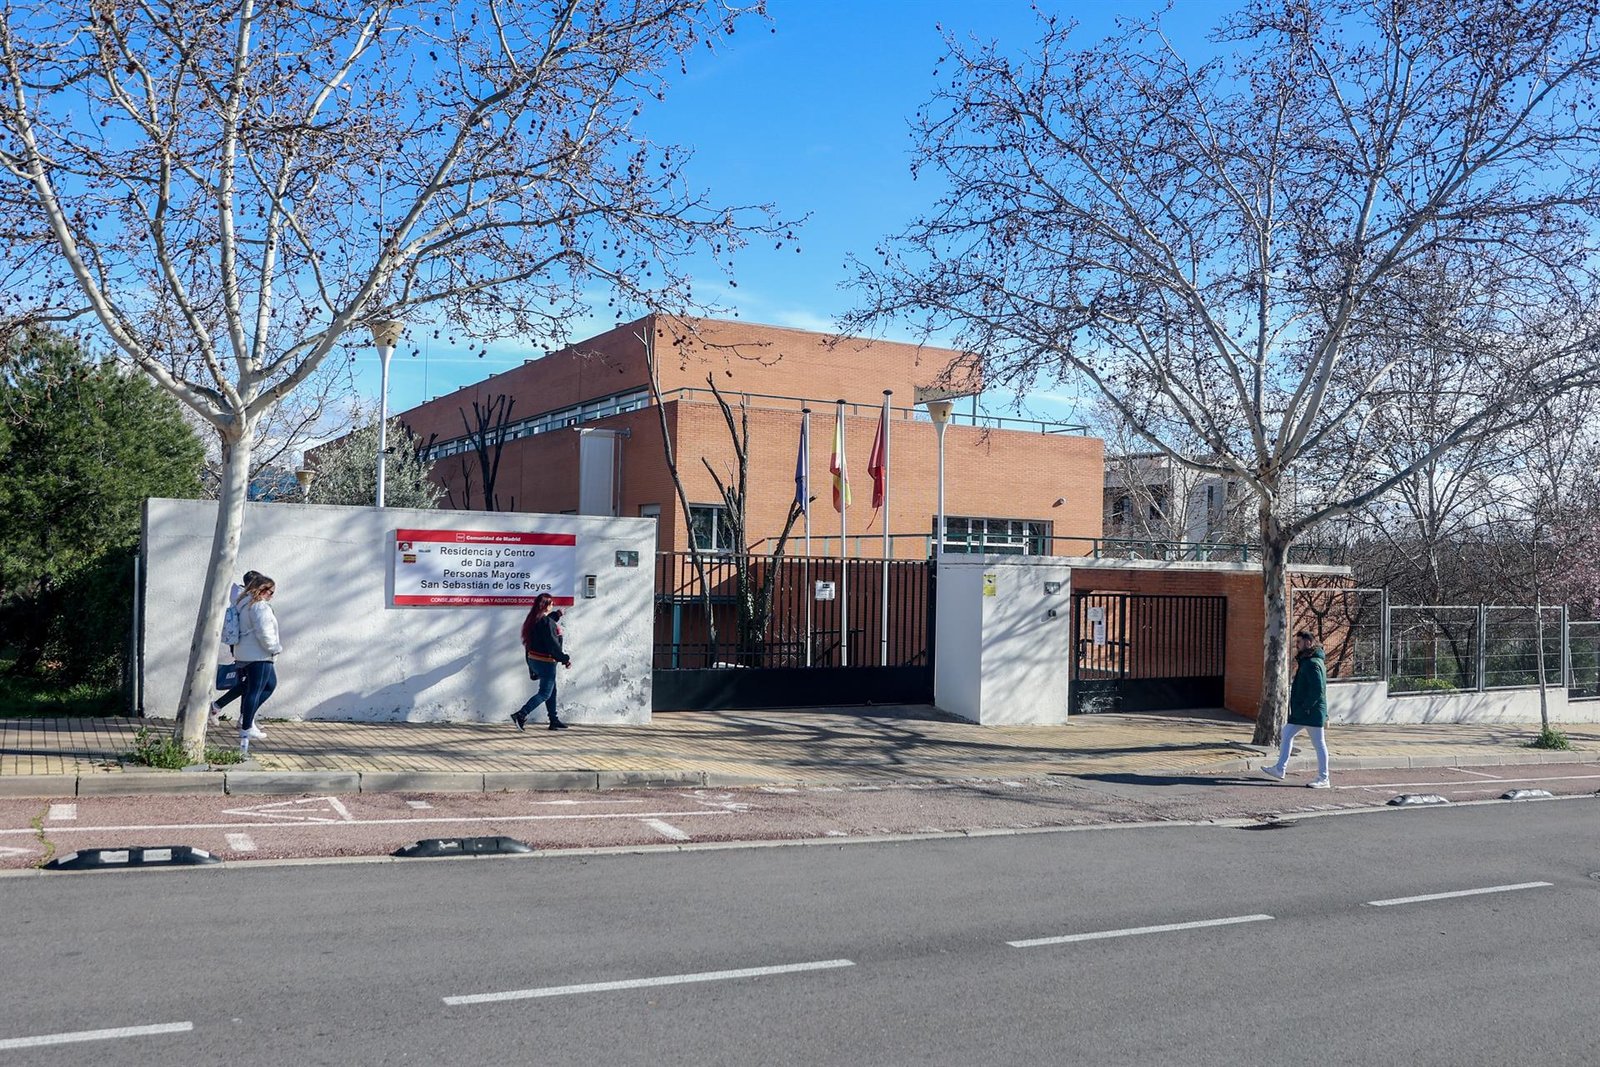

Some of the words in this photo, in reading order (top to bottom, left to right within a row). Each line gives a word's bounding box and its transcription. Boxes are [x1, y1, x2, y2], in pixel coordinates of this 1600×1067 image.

[440, 547, 493, 556] Residencia
[496, 550, 502, 558] y
[504, 548, 536, 557] Centro
[461, 558, 472, 566] de
[494, 560, 514, 568] para
[444, 570, 488, 578] Personas
[492, 570, 530, 580] Mayores
[420, 580, 440, 588] San
[442, 580, 490, 589] Sebastián
[492, 582, 504, 590] de
[506, 582, 520, 590] los
[524, 582, 552, 592] Reyes
